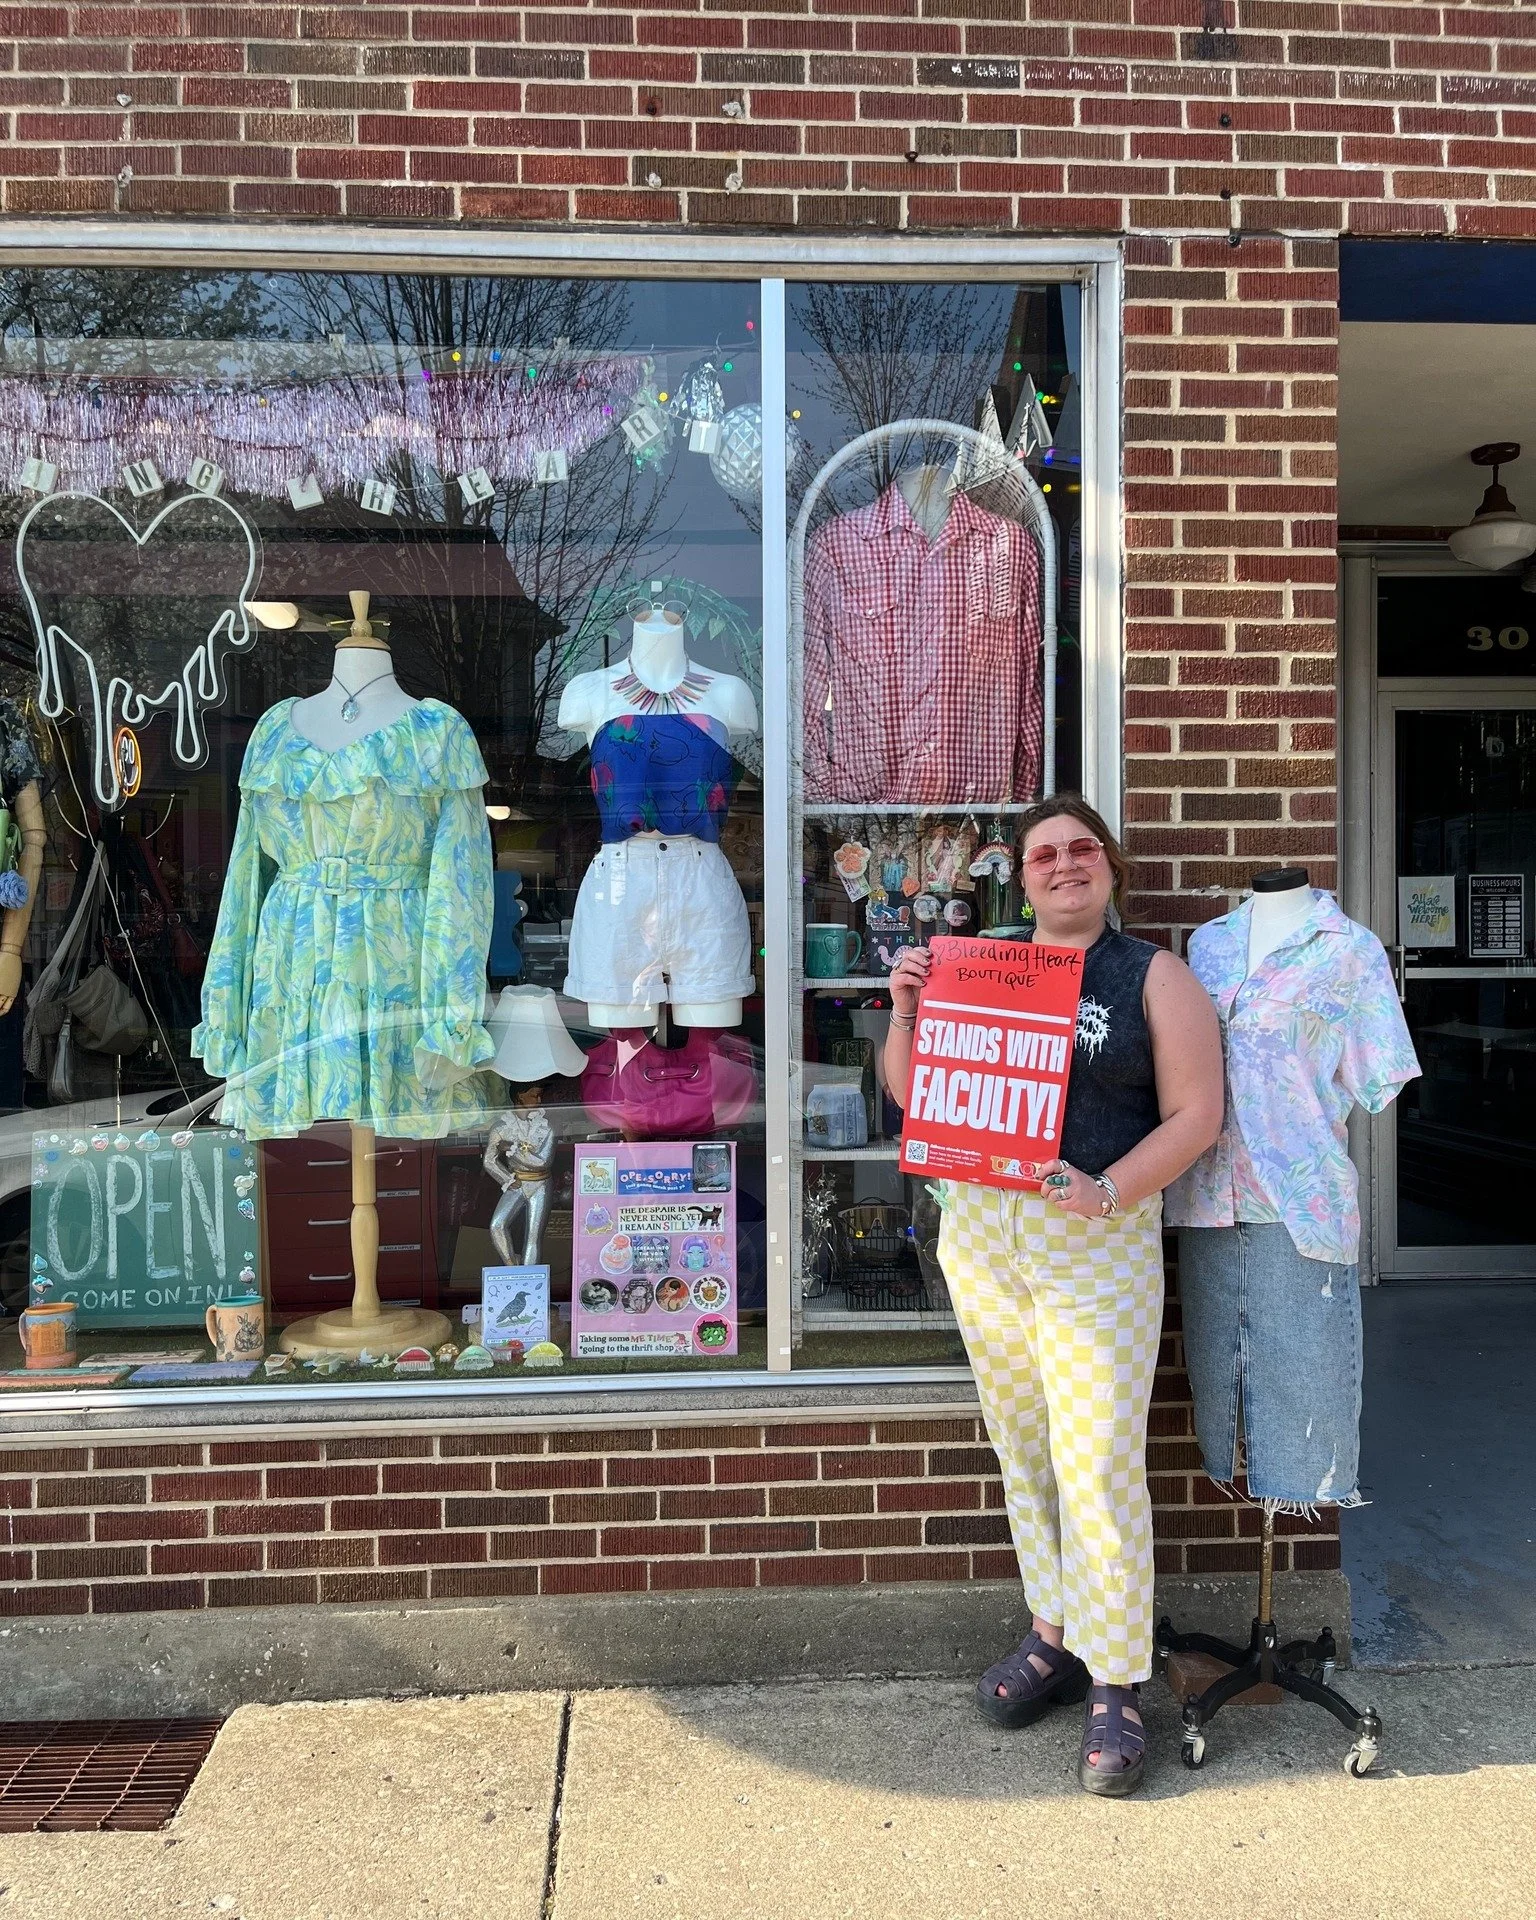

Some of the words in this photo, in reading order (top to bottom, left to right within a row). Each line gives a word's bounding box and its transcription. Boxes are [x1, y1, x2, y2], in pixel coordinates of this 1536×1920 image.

[1467, 626, 1529, 650] 30
[884, 936, 930, 946] THRIV
[946, 940, 1029, 972] Bleeding
[1032, 950, 1082, 975] Heart
[956, 967, 1040, 990] BOUTIQUE
[917, 1018, 1003, 1064] STANDS
[1006, 1028, 1068, 1073] WITH
[909, 1064, 1062, 1141] FACULTY!
[648, 1171, 691, 1184] SORRY!
[47, 1148, 226, 1280] OPEN
[662, 1222, 695, 1231] SILLY
[61, 1289, 136, 1309] COME
[144, 1286, 180, 1307] ON
[580, 1335, 607, 1343] Taking
[655, 1344, 674, 1352] shop
